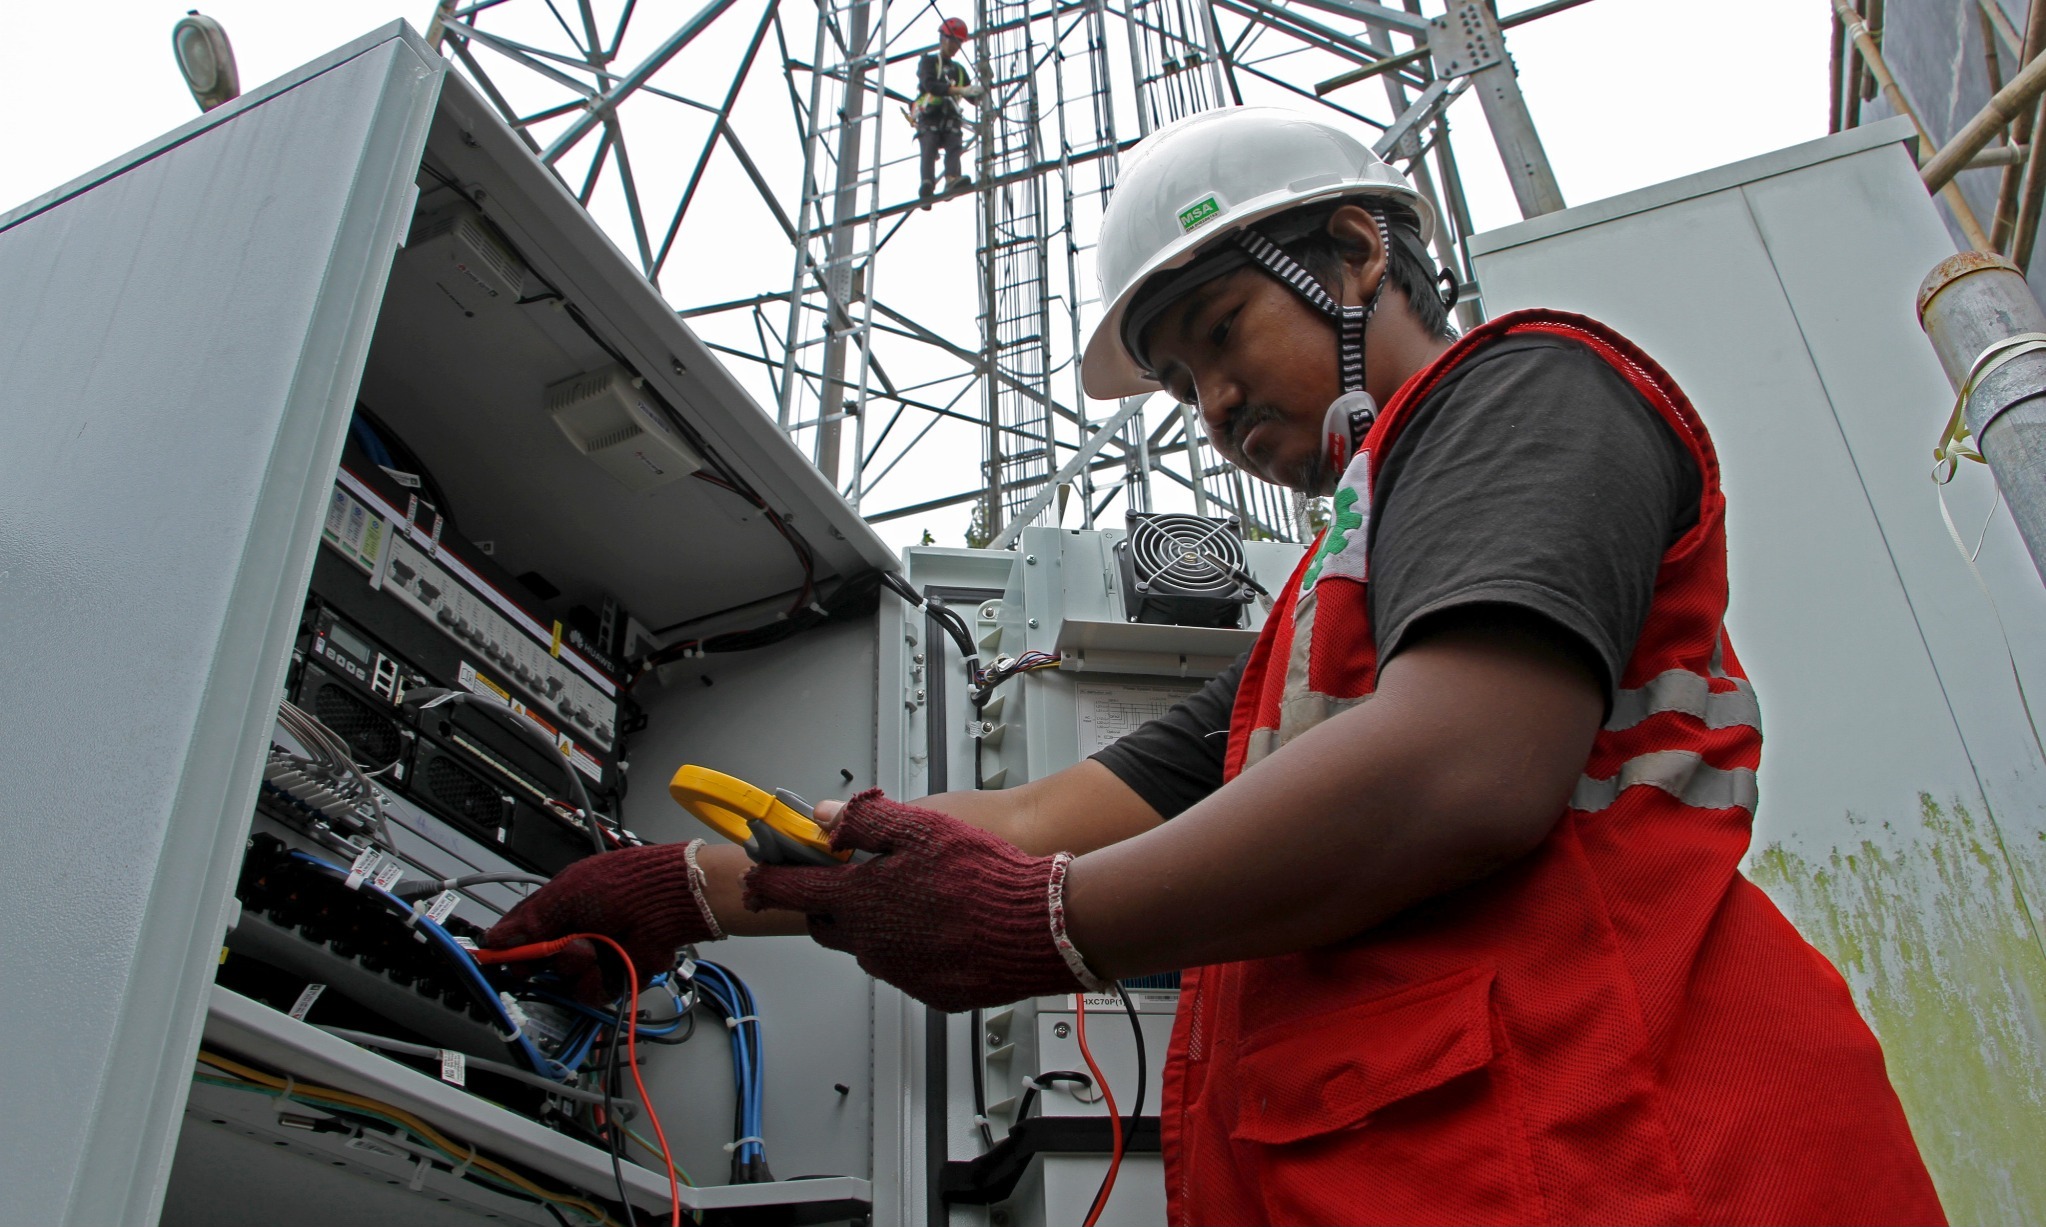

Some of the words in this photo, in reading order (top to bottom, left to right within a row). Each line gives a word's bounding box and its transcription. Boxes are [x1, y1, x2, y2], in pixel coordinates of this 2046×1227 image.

[1180, 203, 1213, 226] MSA
[583, 642, 615, 673] HUAWEI
[1083, 998, 1126, 1006] HXC70P(1
